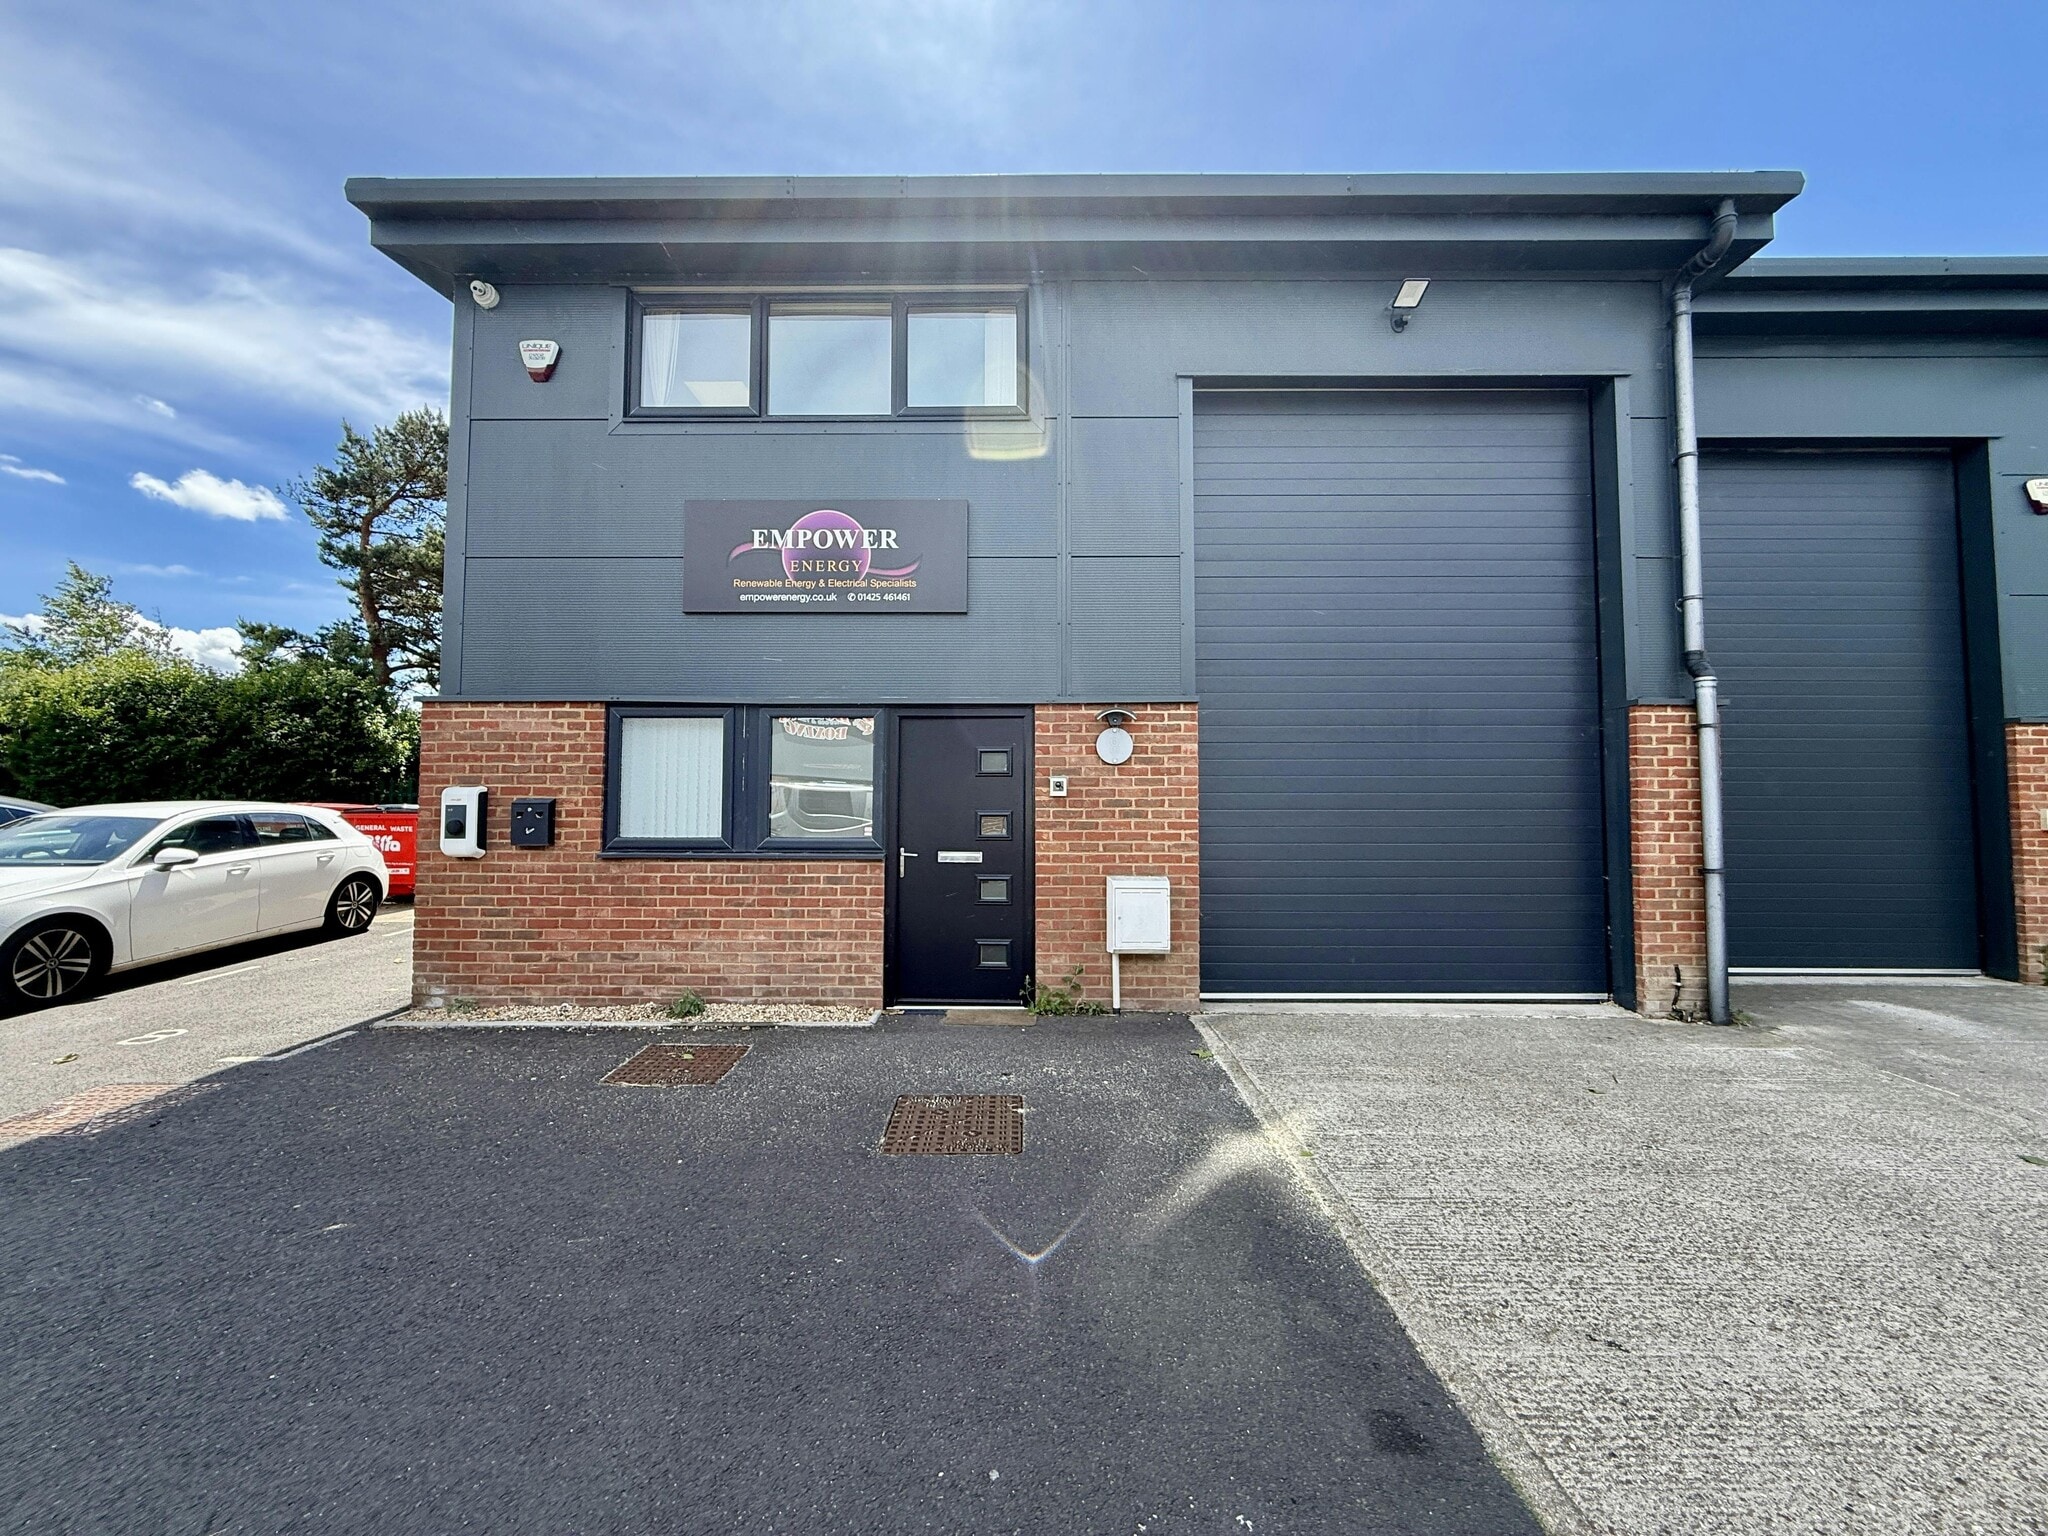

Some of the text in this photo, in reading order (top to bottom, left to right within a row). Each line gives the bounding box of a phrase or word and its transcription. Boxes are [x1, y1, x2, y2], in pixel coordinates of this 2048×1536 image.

[751, 529, 899, 549] EMPOWER
[790, 560, 862, 572] ENERGY
[733, 579, 917, 590] Renewable Energy & Electrical Specialists
[740, 592, 911, 603] empowerenergy.co.uk 01425 461461
[366, 835, 401, 852] iffa
